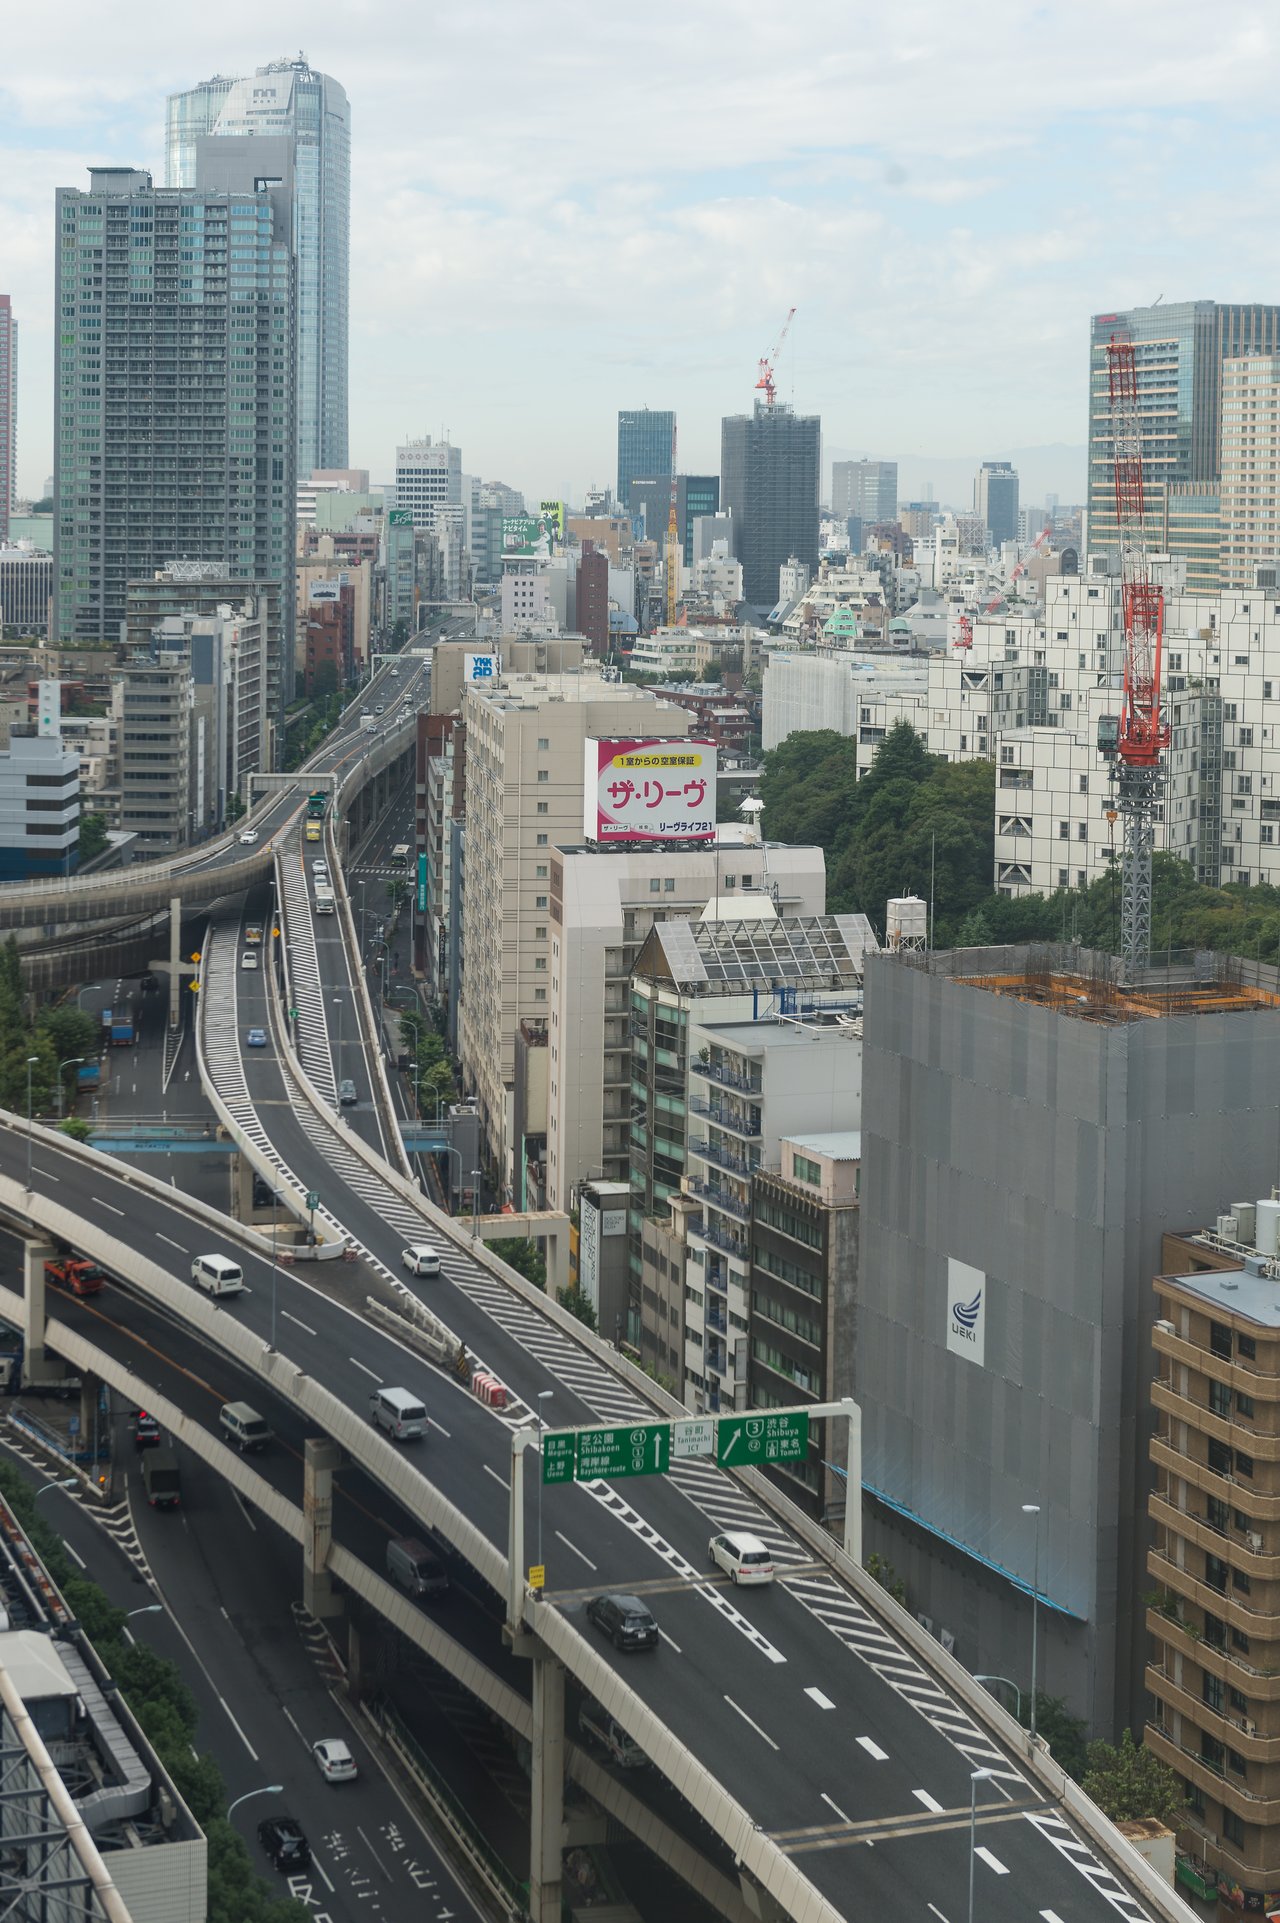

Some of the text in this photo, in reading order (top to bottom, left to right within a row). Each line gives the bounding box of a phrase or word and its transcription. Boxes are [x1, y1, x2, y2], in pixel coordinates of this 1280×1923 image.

[540, 502, 559, 511] DMM
[472, 656, 492, 667] YKK
[620, 756, 695, 766] 1室からの空室保証
[607, 778, 707, 809] ザ・リーヴ
[659, 822, 713, 832] リーヴライフ21
[952, 1323, 976, 1342] UEKI
[767, 1417, 789, 1428] 渋谷
[684, 1425, 704, 1435] 谷町
[766, 1427, 799, 1437] Shibuya
[581, 1433, 614, 1445] 芝公園
[677, 1435, 711, 1444] Tanimachi
[780, 1438, 800, 1449] 東名
[548, 1440, 566, 1449] 目黒
[580, 1444, 620, 1454] Shibakoen
[687, 1444, 699, 1453] JCT
[547, 1448, 572, 1457] Meguro
[780, 1447, 801, 1457] Tomei
[548, 1461, 565, 1471] 上野
[580, 1455, 610, 1467] 湾岸線
[546, 1470, 564, 1478] Ueno
